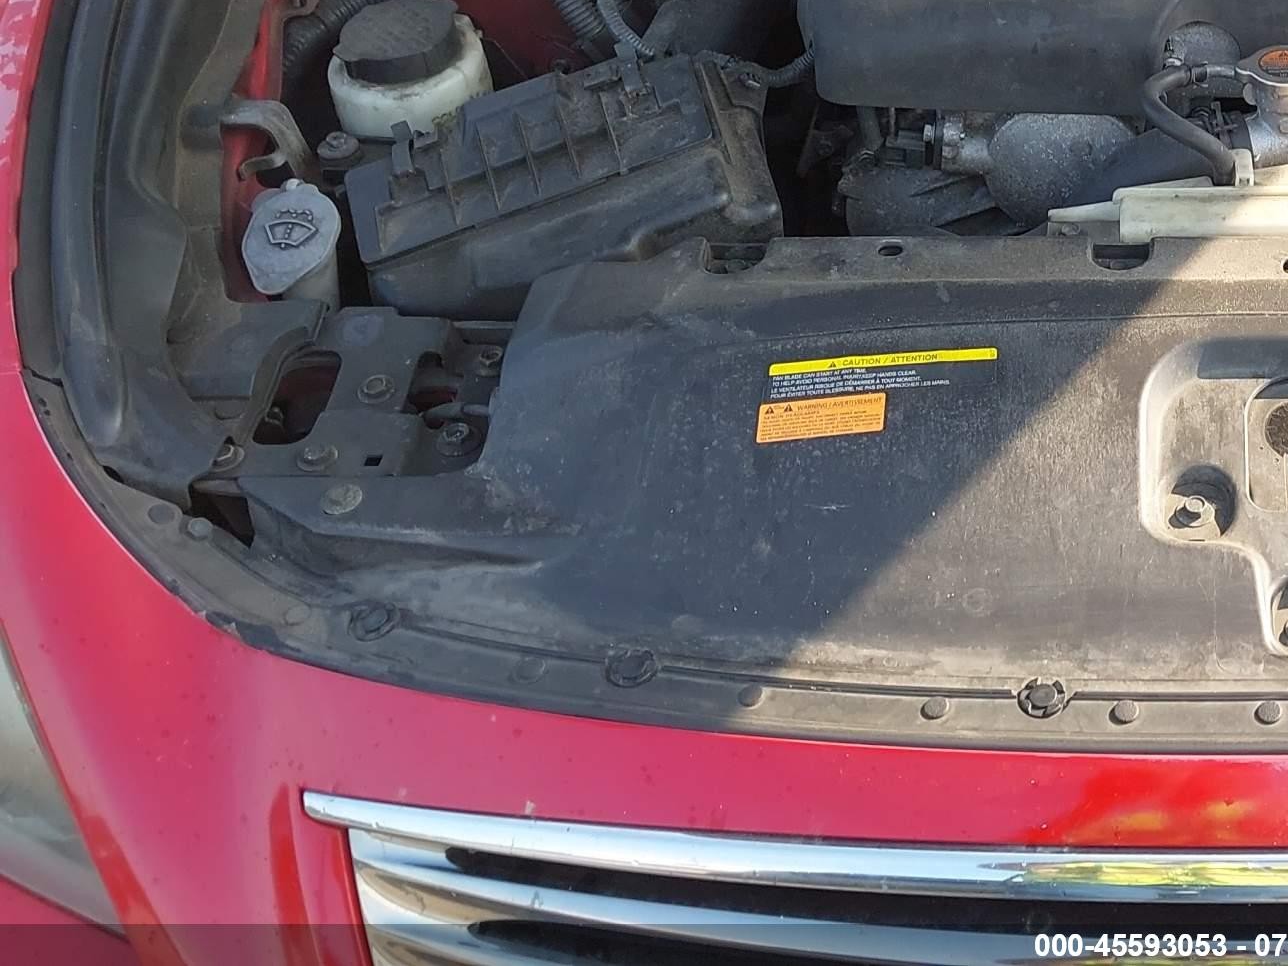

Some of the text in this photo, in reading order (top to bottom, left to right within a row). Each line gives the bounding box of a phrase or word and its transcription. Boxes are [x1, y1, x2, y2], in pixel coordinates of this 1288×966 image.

[843, 353, 938, 366] CAUTION / ATTENTION
[815, 370, 833, 378] START
[797, 403, 827, 412] WARNING
[832, 397, 882, 408] AVERTISSEMENT
